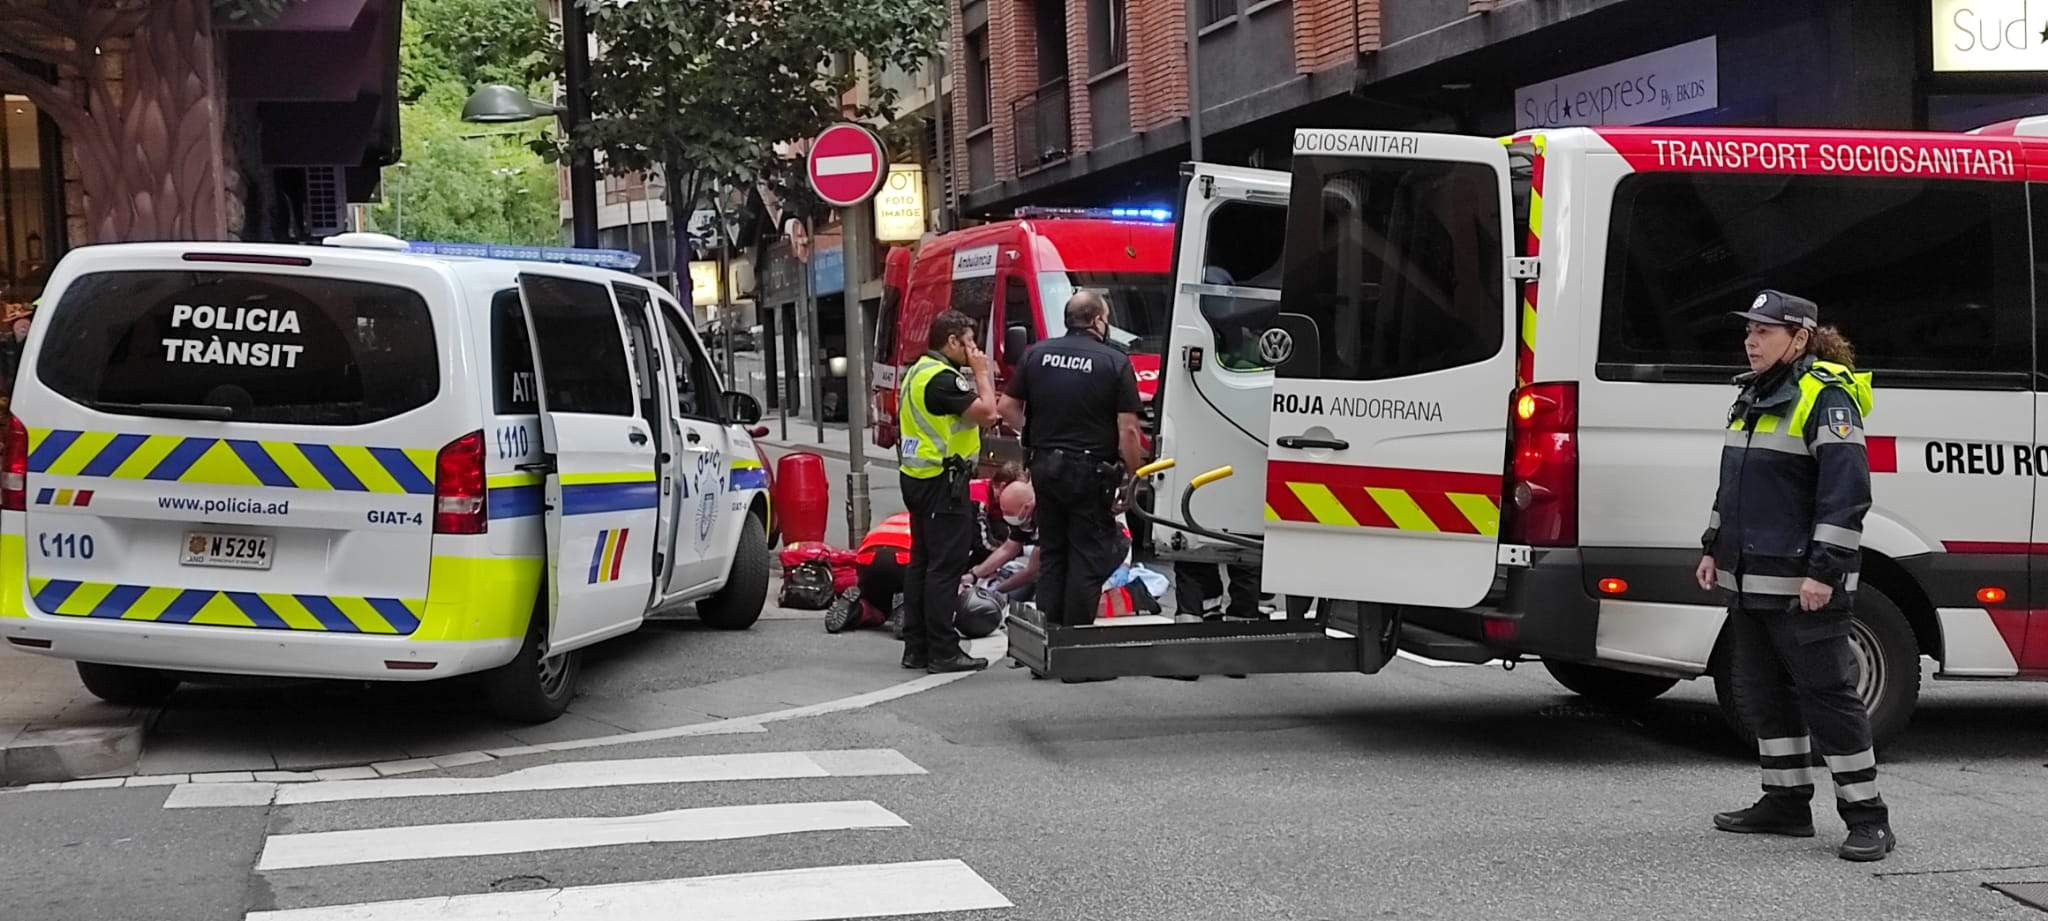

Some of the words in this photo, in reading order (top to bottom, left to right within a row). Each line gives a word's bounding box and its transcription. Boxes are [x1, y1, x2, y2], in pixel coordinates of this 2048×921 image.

[1953, 0, 2028, 51] Sud
[1524, 84, 1559, 127] Sud
[1575, 74, 1657, 125] express
[1661, 88, 1673, 110] By
[1676, 80, 1705, 101] BKDS
[1294, 132, 1419, 154] OCIOSANITARI
[1651, 140, 1810, 170] TRANSPORT
[1819, 143, 2015, 176] SOCIOSANITARI
[881, 208, 921, 217] IMATGE
[885, 196, 914, 205] FOTO
[171, 304, 301, 334] POLICIA
[162, 335, 304, 368] TRÀNSIT
[1042, 354, 1093, 374] POLICIA
[1272, 393, 1324, 415] ROJA
[1329, 396, 1443, 422] ANDORRANA
[504, 425, 528, 458] 110
[1925, 441, 2005, 475] CREU
[158, 496, 289, 515] www.policia.ad
[367, 510, 422, 525] GIAT-4
[52, 532, 94, 560] 110
[211, 536, 223, 557] N
[225, 537, 266, 559] 5294
